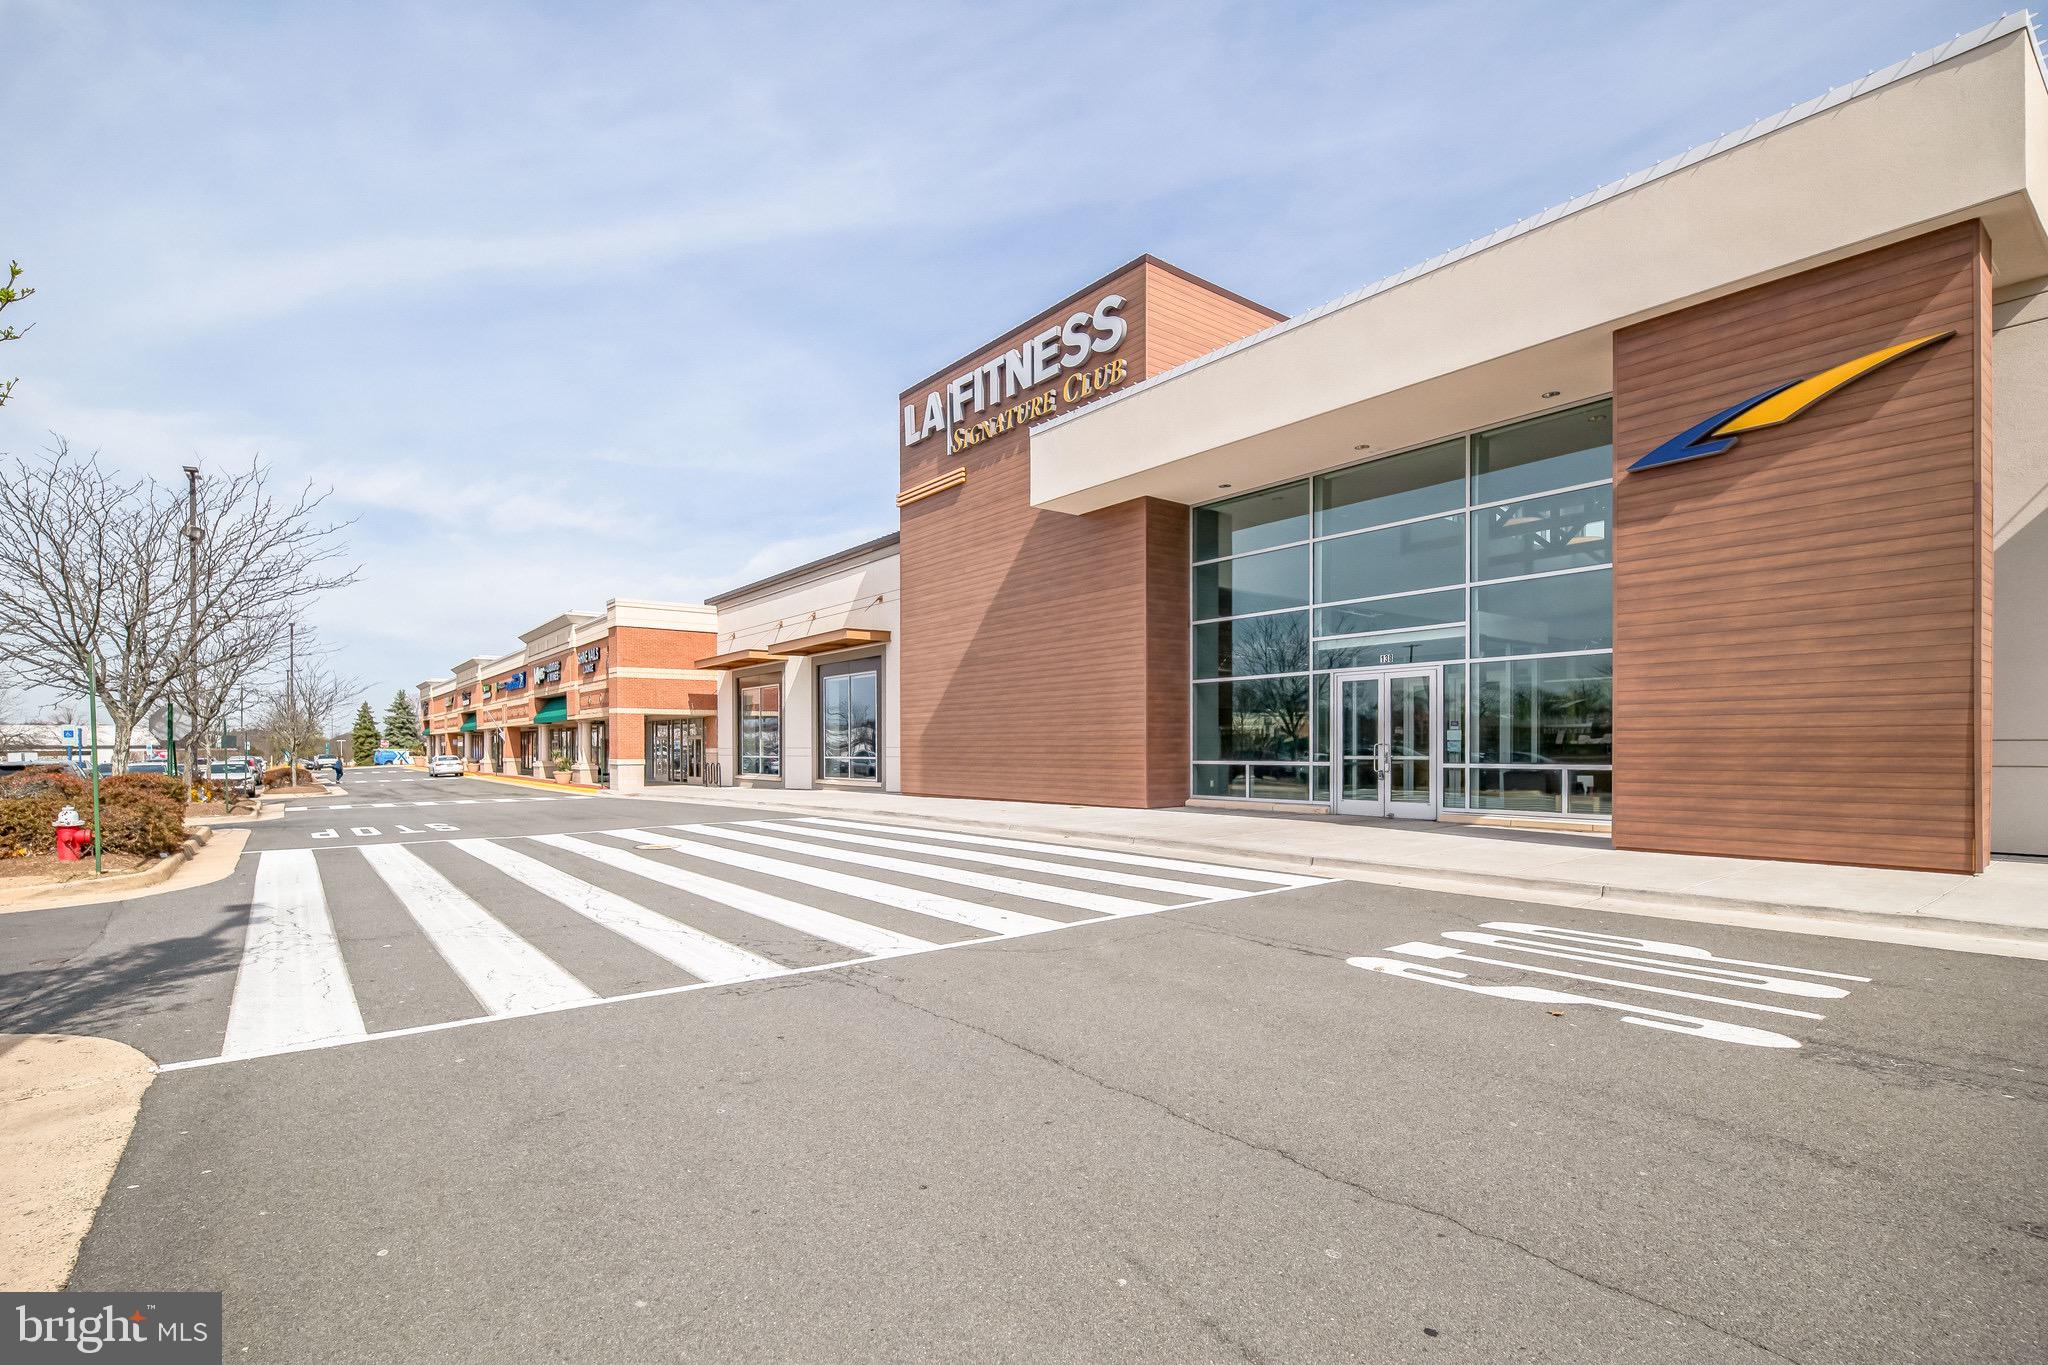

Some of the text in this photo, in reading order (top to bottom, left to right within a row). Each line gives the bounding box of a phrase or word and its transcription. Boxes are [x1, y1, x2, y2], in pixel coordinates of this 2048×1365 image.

[904, 294, 1128, 447] LA FITNESS
[952, 358, 1128, 454] SIGNATURE CLUB
[311, 823, 461, 839] STOP
